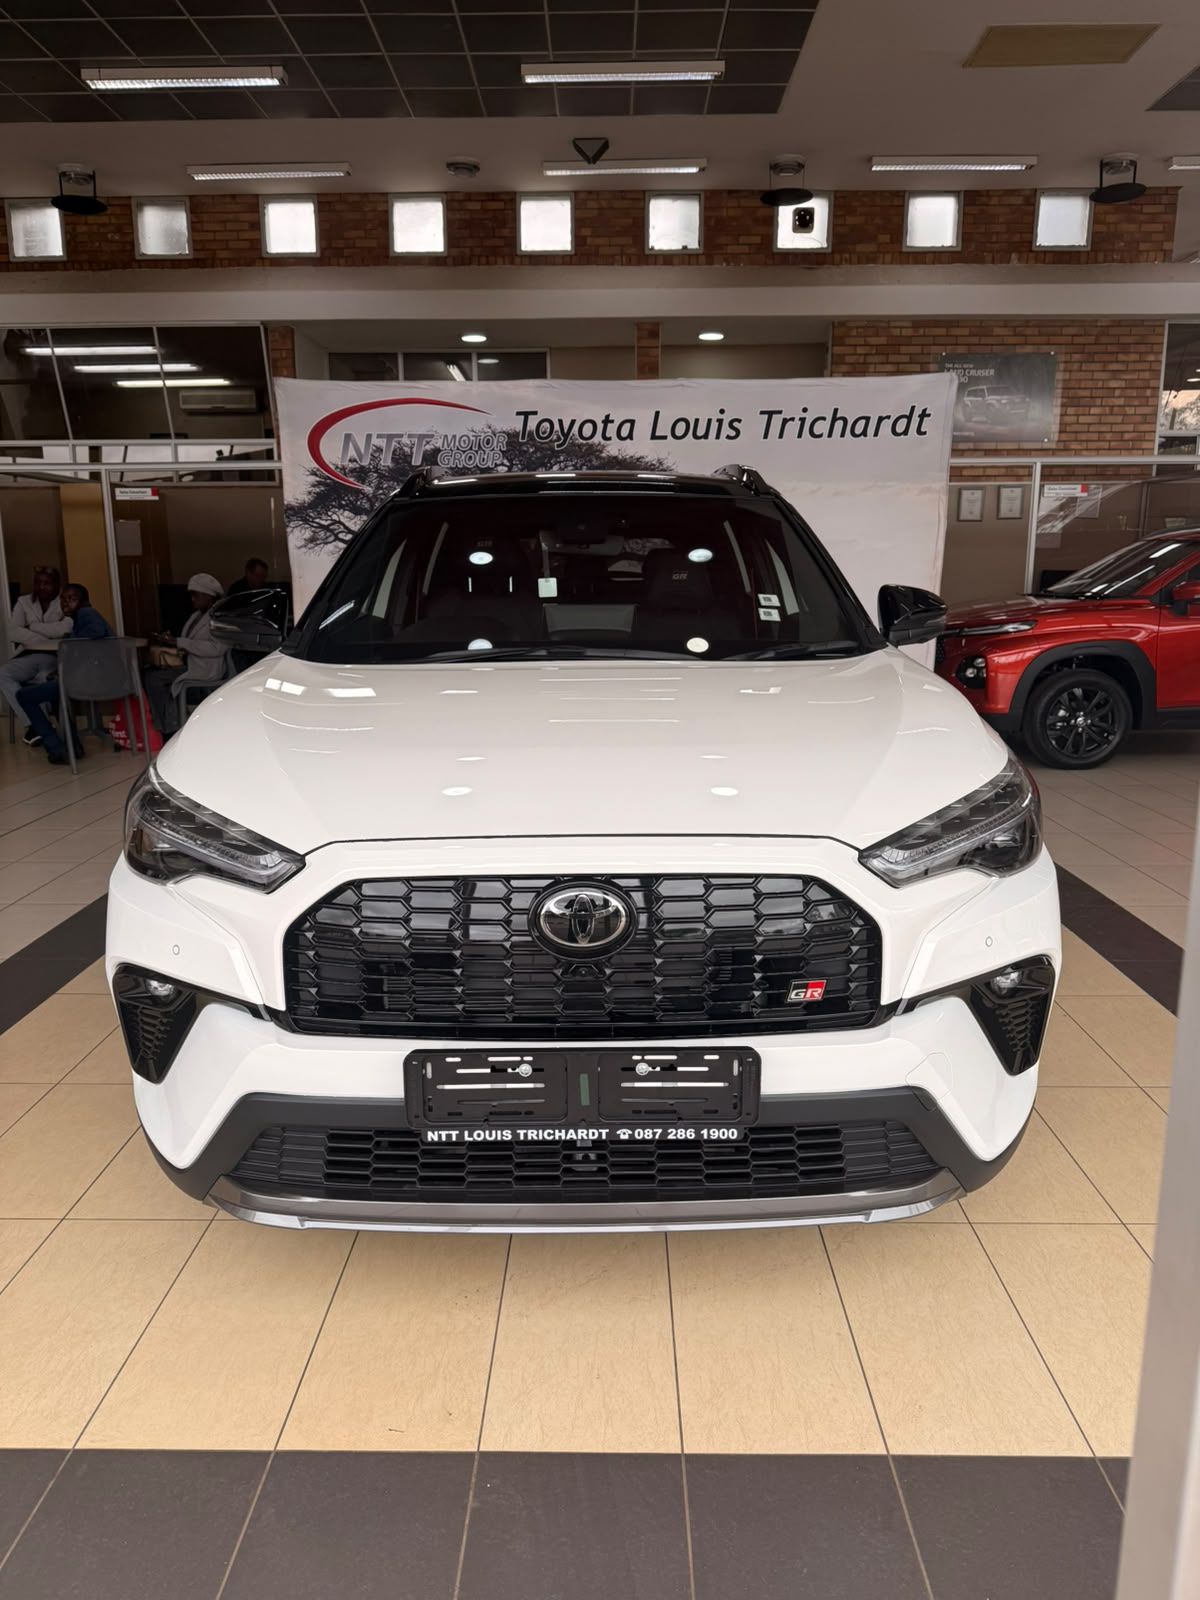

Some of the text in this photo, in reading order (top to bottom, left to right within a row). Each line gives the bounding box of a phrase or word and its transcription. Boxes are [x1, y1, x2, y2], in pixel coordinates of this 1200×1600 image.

[965, 368, 995, 376] CRUISER
[515, 404, 931, 448] Toyota Louis Trichardt
[339, 432, 435, 466] NTT
[440, 433, 508, 451] MOTOR
[437, 450, 503, 468] GROUP
[790, 988, 823, 999] GR
[427, 1128, 738, 1142] NTT LOUIS TRICHARDT 087 286 1900
